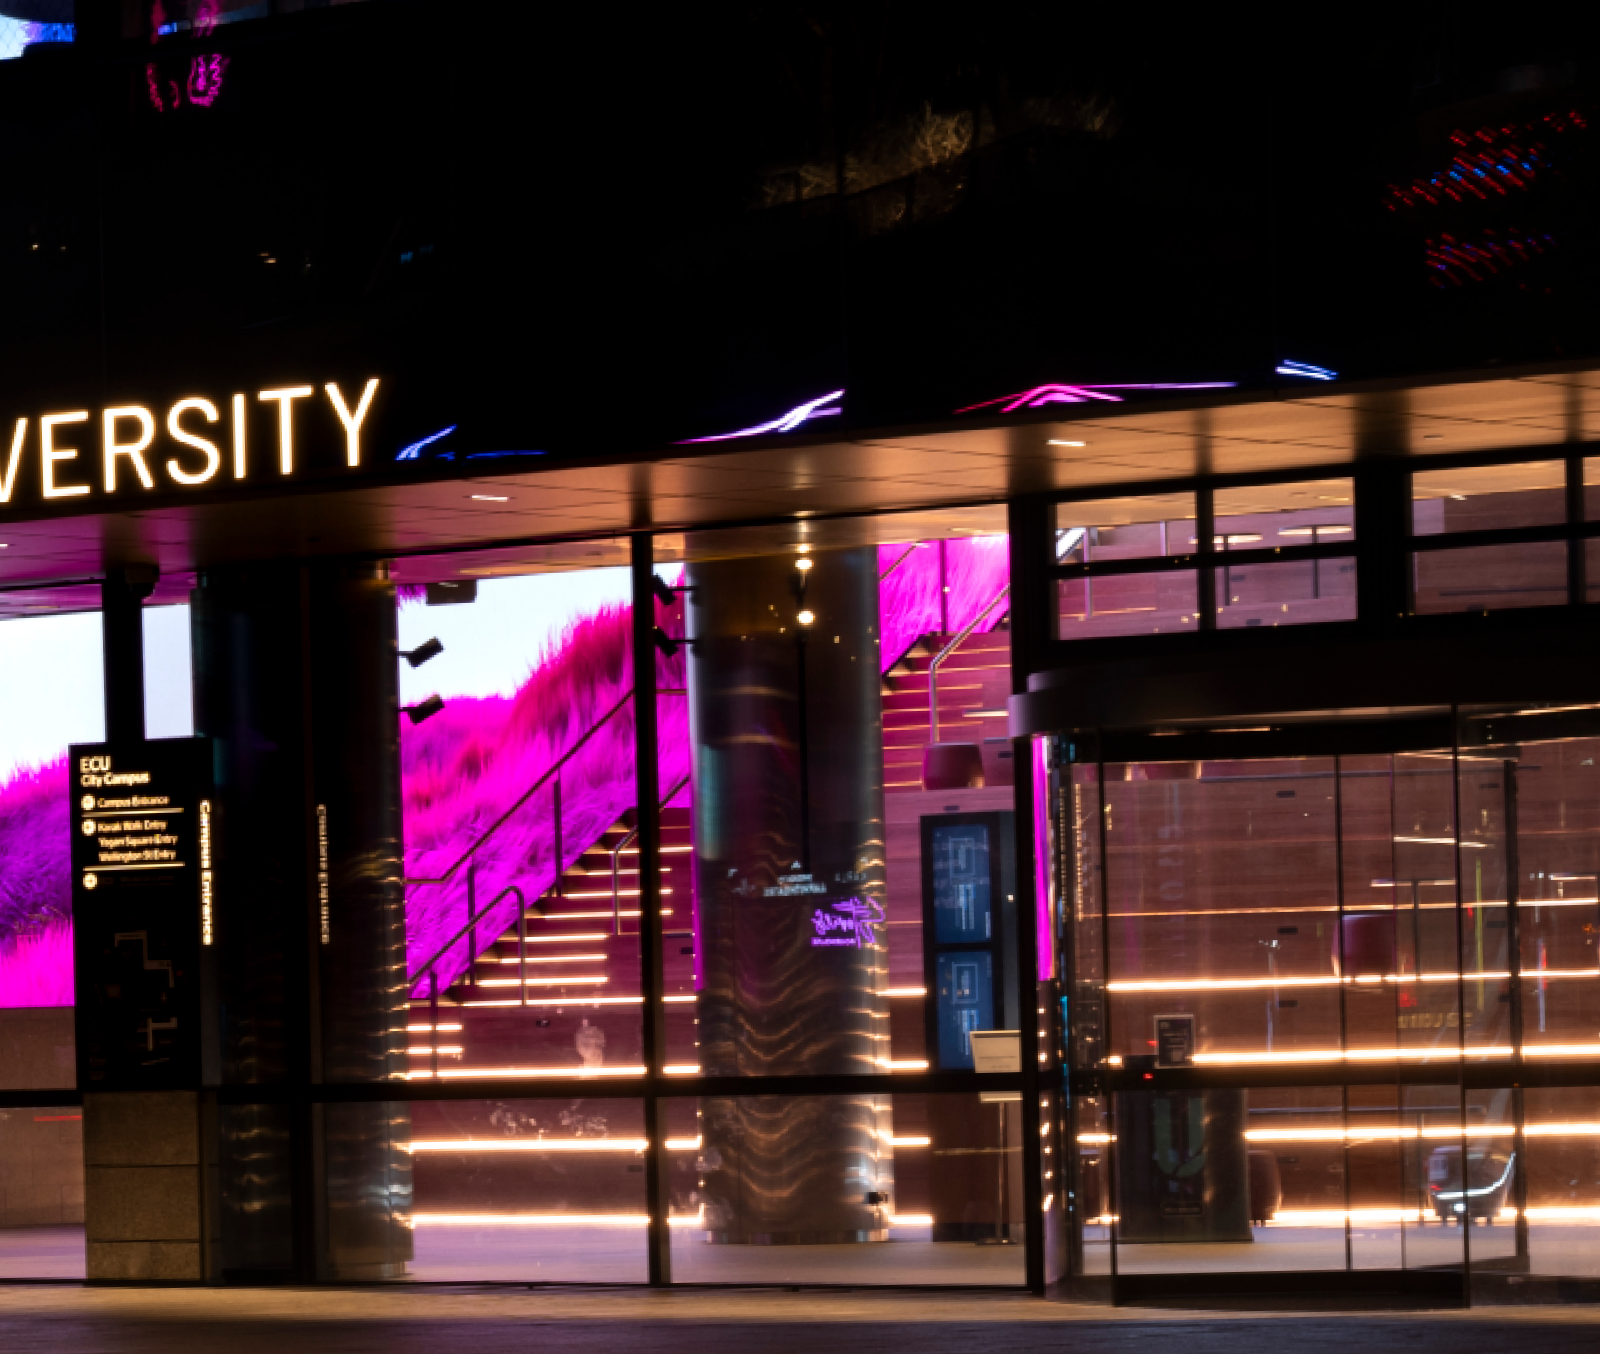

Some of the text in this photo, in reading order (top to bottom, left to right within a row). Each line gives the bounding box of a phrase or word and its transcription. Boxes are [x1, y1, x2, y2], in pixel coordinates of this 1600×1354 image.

[80, 756, 111, 773] ECU
[81, 771, 150, 788] City Campus
